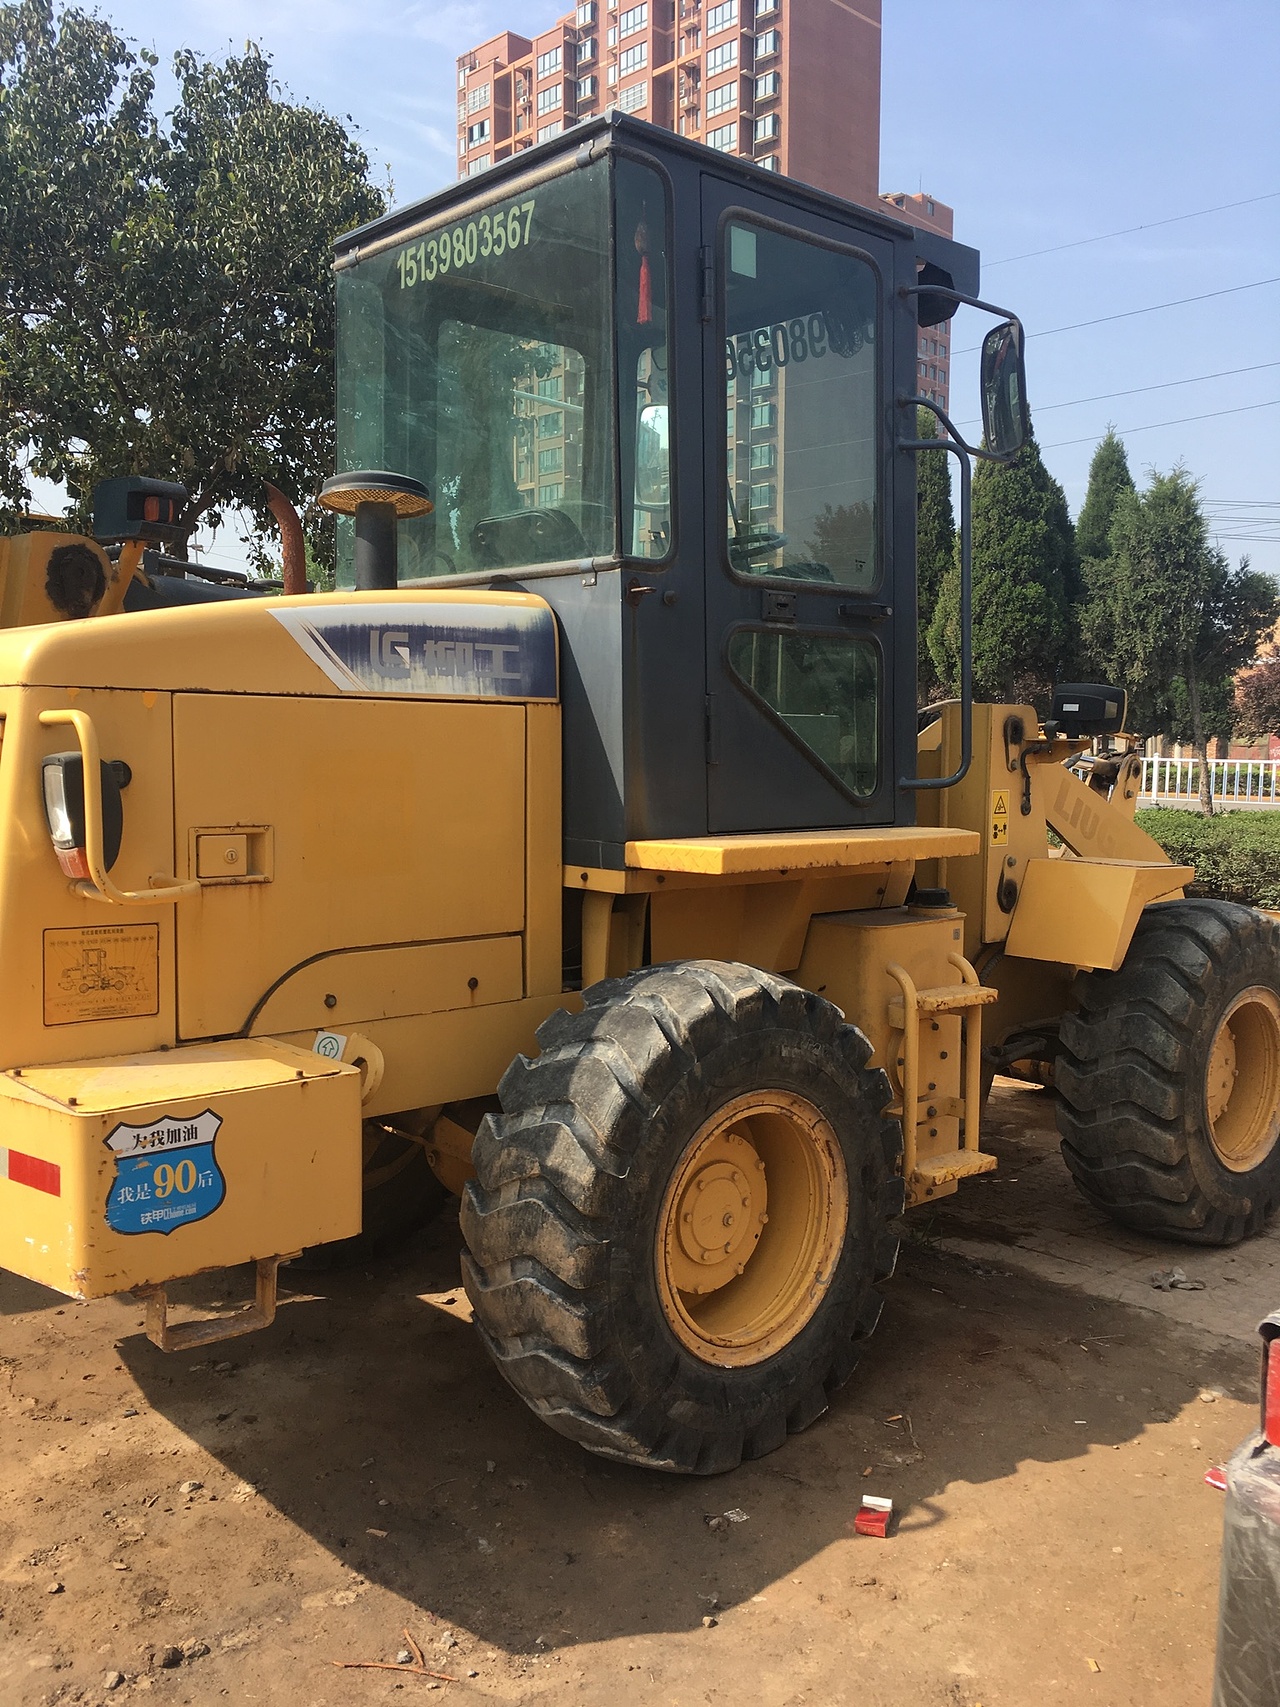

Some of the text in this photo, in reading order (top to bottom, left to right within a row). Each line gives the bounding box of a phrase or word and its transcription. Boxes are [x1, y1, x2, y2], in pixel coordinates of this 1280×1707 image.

[397, 200, 536, 290] 15139803567
[132, 1124, 198, 1150] 为我加油
